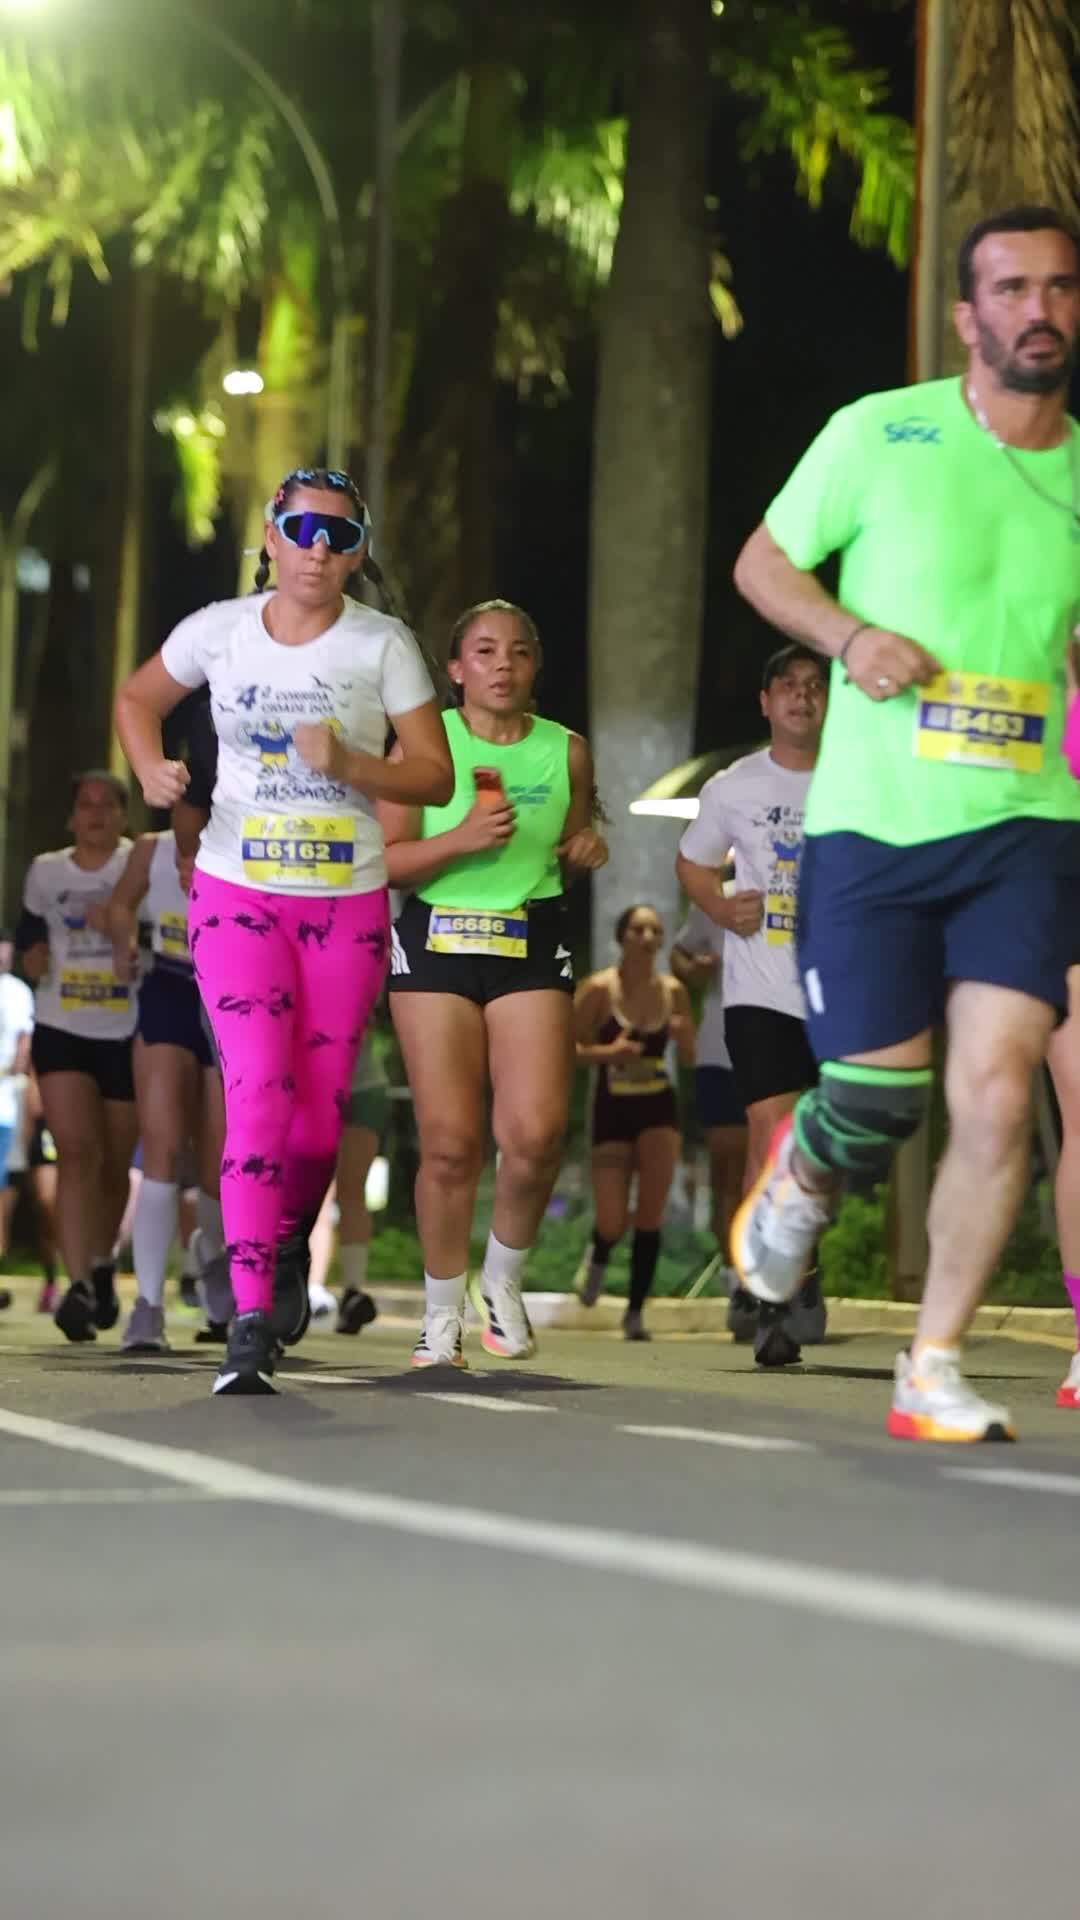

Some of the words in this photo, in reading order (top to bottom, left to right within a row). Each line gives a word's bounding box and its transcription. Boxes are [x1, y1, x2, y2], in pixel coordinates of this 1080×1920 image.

[950, 706, 1026, 739] 5453
[266, 841, 331, 861] 6162
[453, 917, 506, 934] 6686
